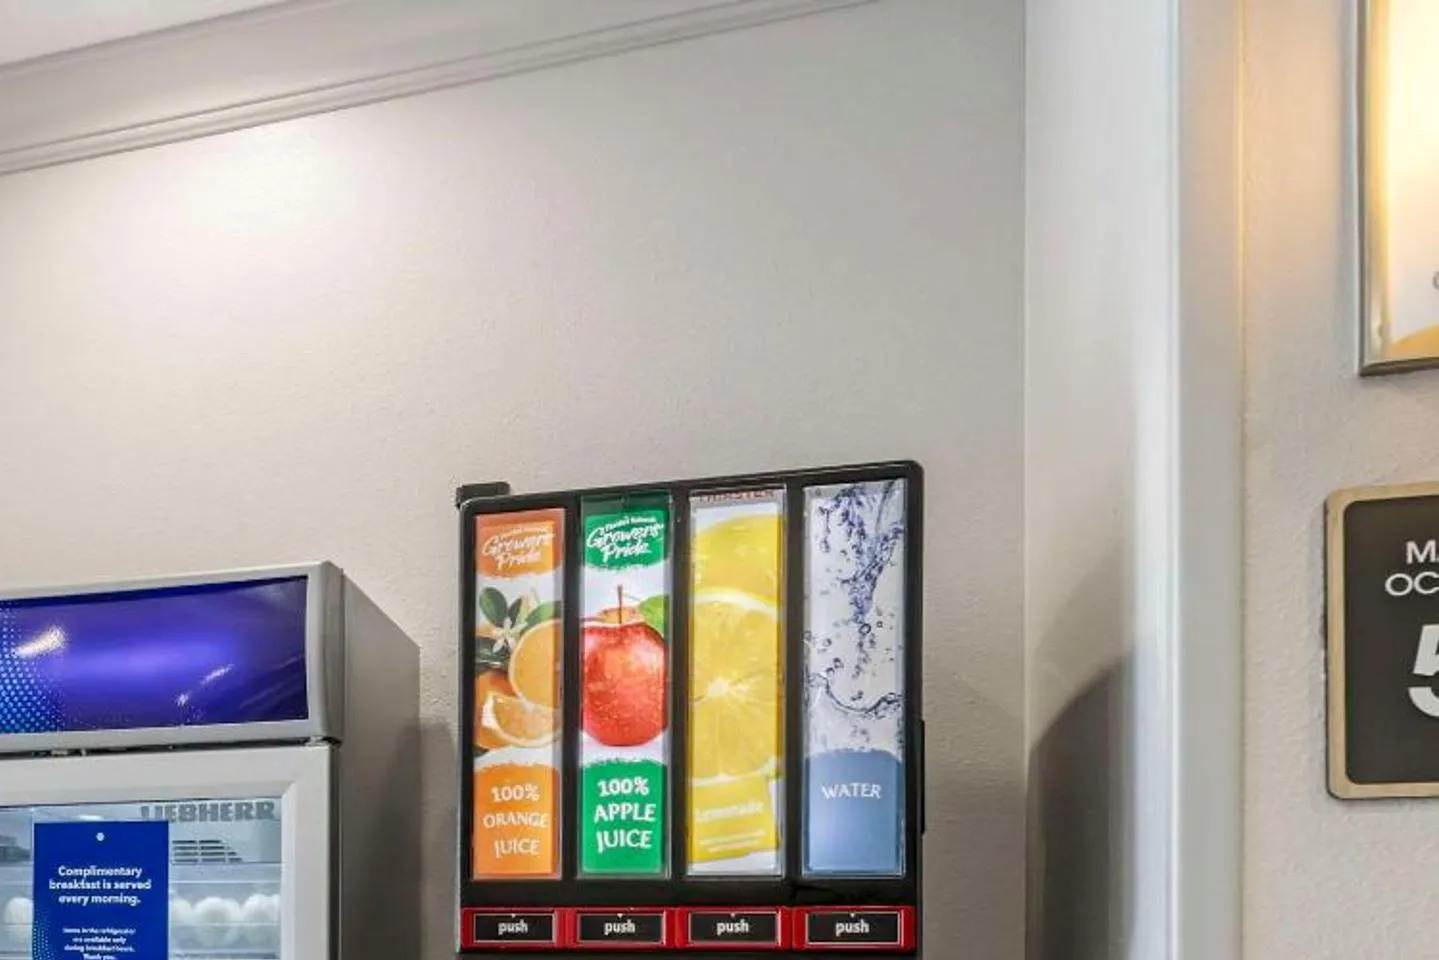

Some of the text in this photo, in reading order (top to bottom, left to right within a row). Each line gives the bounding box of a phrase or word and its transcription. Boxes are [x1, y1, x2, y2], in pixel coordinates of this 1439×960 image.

[600, 540, 652, 563] Pride
[491, 784, 540, 802] 100%
[598, 777, 649, 797] 100%
[821, 782, 881, 800] WATER
[483, 812, 548, 828] ORANGE
[594, 803, 656, 823] APPLE
[494, 838, 540, 859] JUICE
[596, 829, 653, 853] JUICE
[58, 865, 143, 878] Complimentary
[48, 878, 152, 890] breakfast is served
[58, 892, 141, 906] every morning.
[498, 919, 529, 935] push
[604, 919, 636, 936] push
[716, 919, 750, 936] push
[835, 919, 870, 936] push
